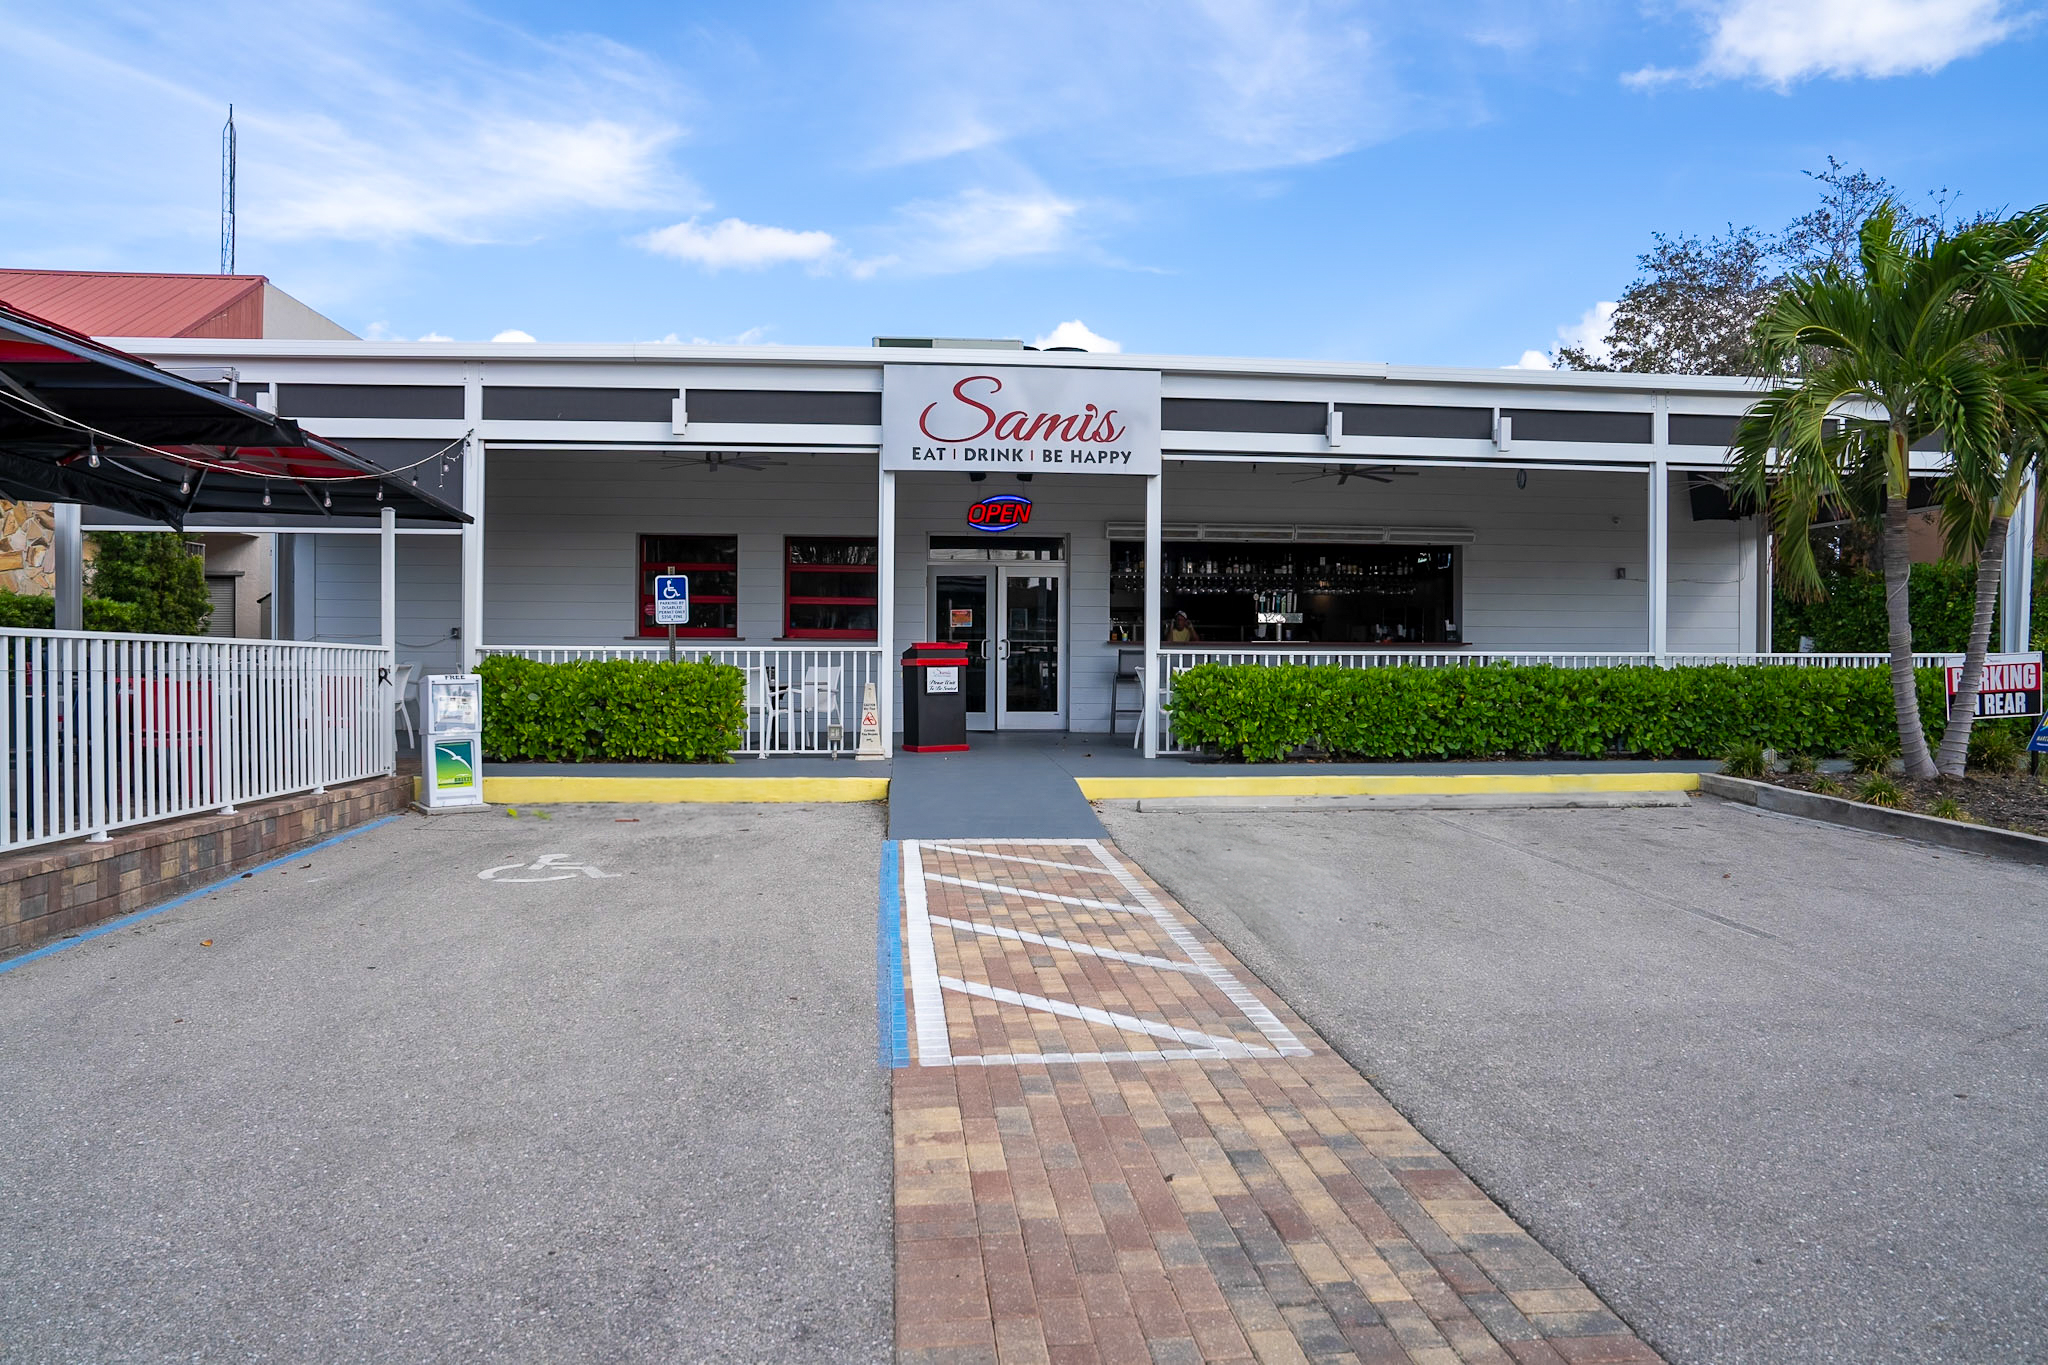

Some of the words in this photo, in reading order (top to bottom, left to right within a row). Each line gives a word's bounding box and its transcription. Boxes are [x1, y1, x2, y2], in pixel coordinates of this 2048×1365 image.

[912, 447, 946, 461] EAT
[964, 448, 1023, 463] DRINK
[1042, 450, 1063, 463] BE
[1070, 450, 1132, 465] HAPPY
[968, 504, 1032, 523] OPEN
[1952, 664, 2036, 693] PRKING
[1984, 692, 2027, 715] REAR
